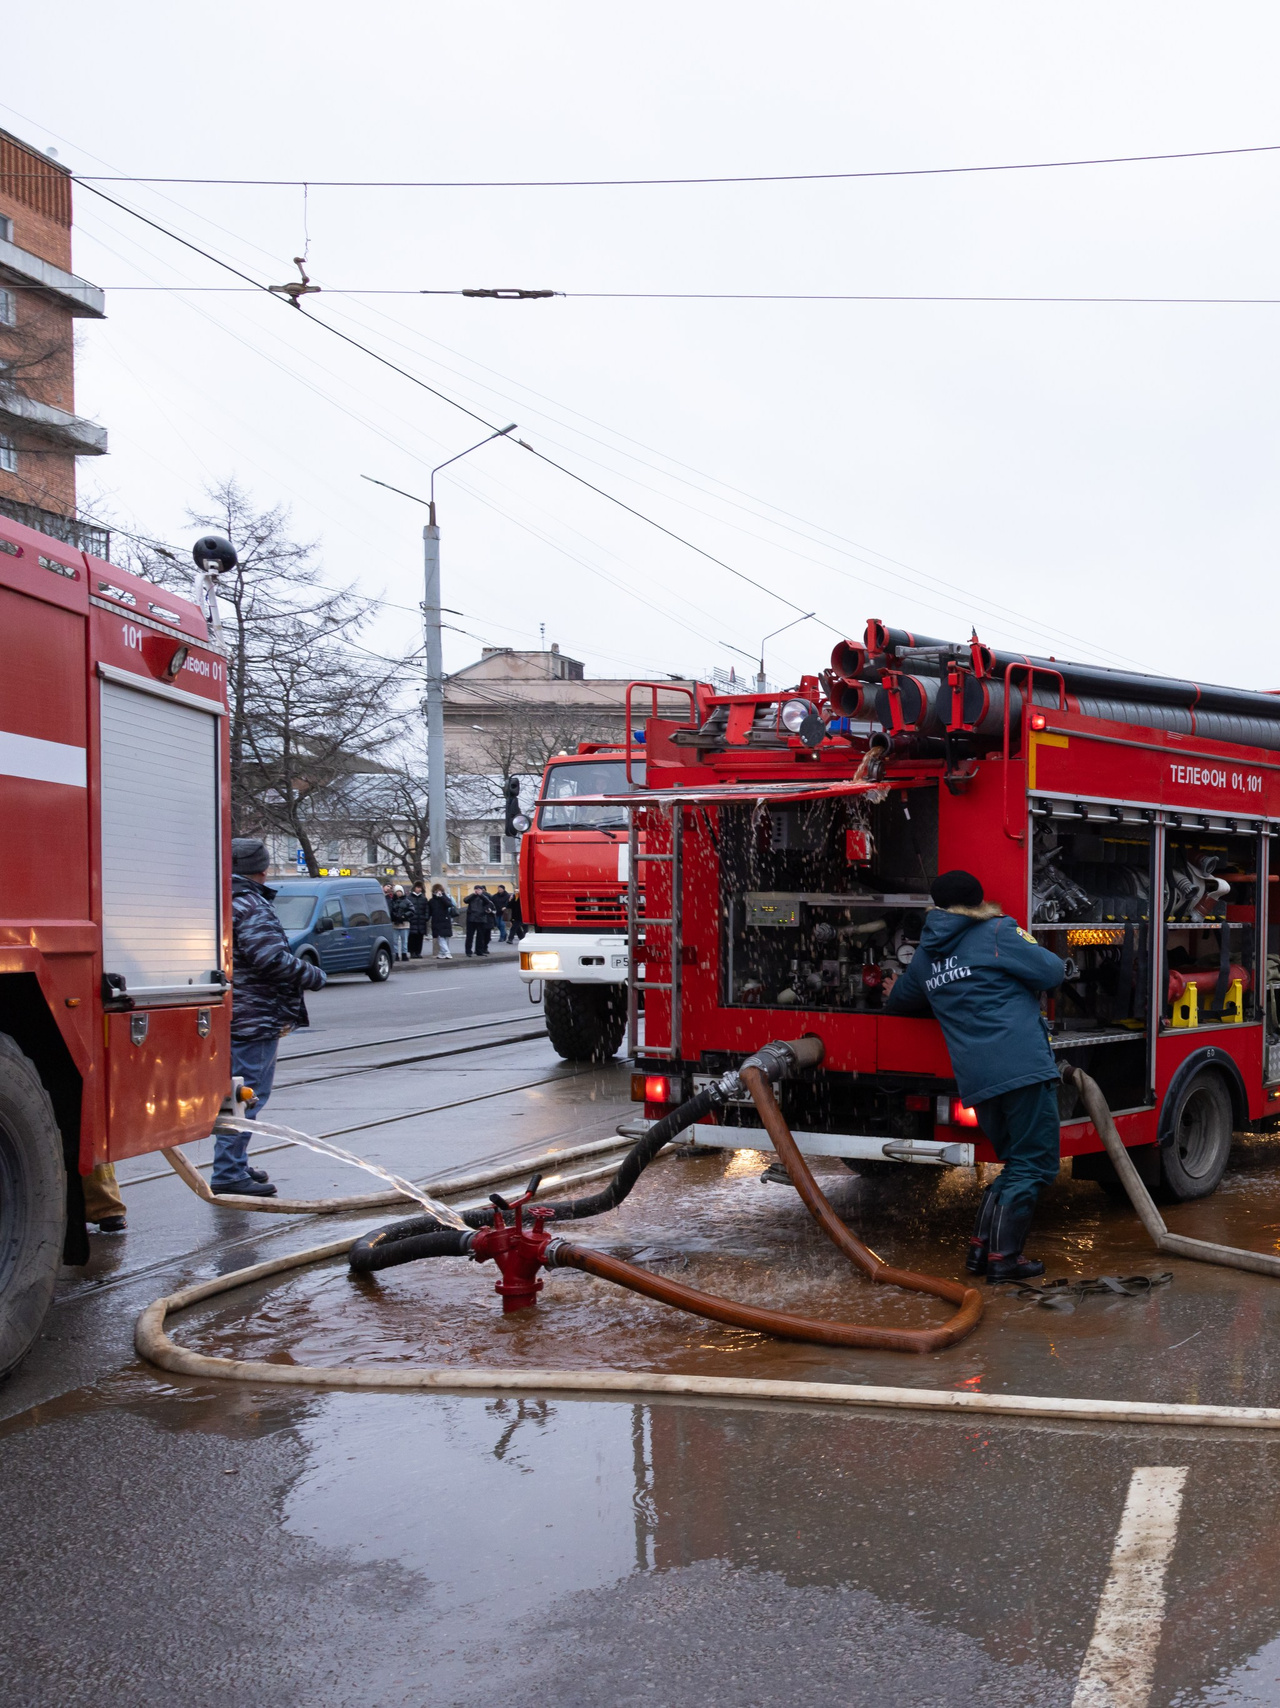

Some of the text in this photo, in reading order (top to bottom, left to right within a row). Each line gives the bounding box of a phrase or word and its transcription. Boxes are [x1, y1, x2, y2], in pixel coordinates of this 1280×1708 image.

[122, 624, 222, 681] 101 ЛЕФОН 01
[1170, 764, 1262, 793] ТЕЛЕФОН 01,101
[925, 966, 972, 992] РОССИИ
